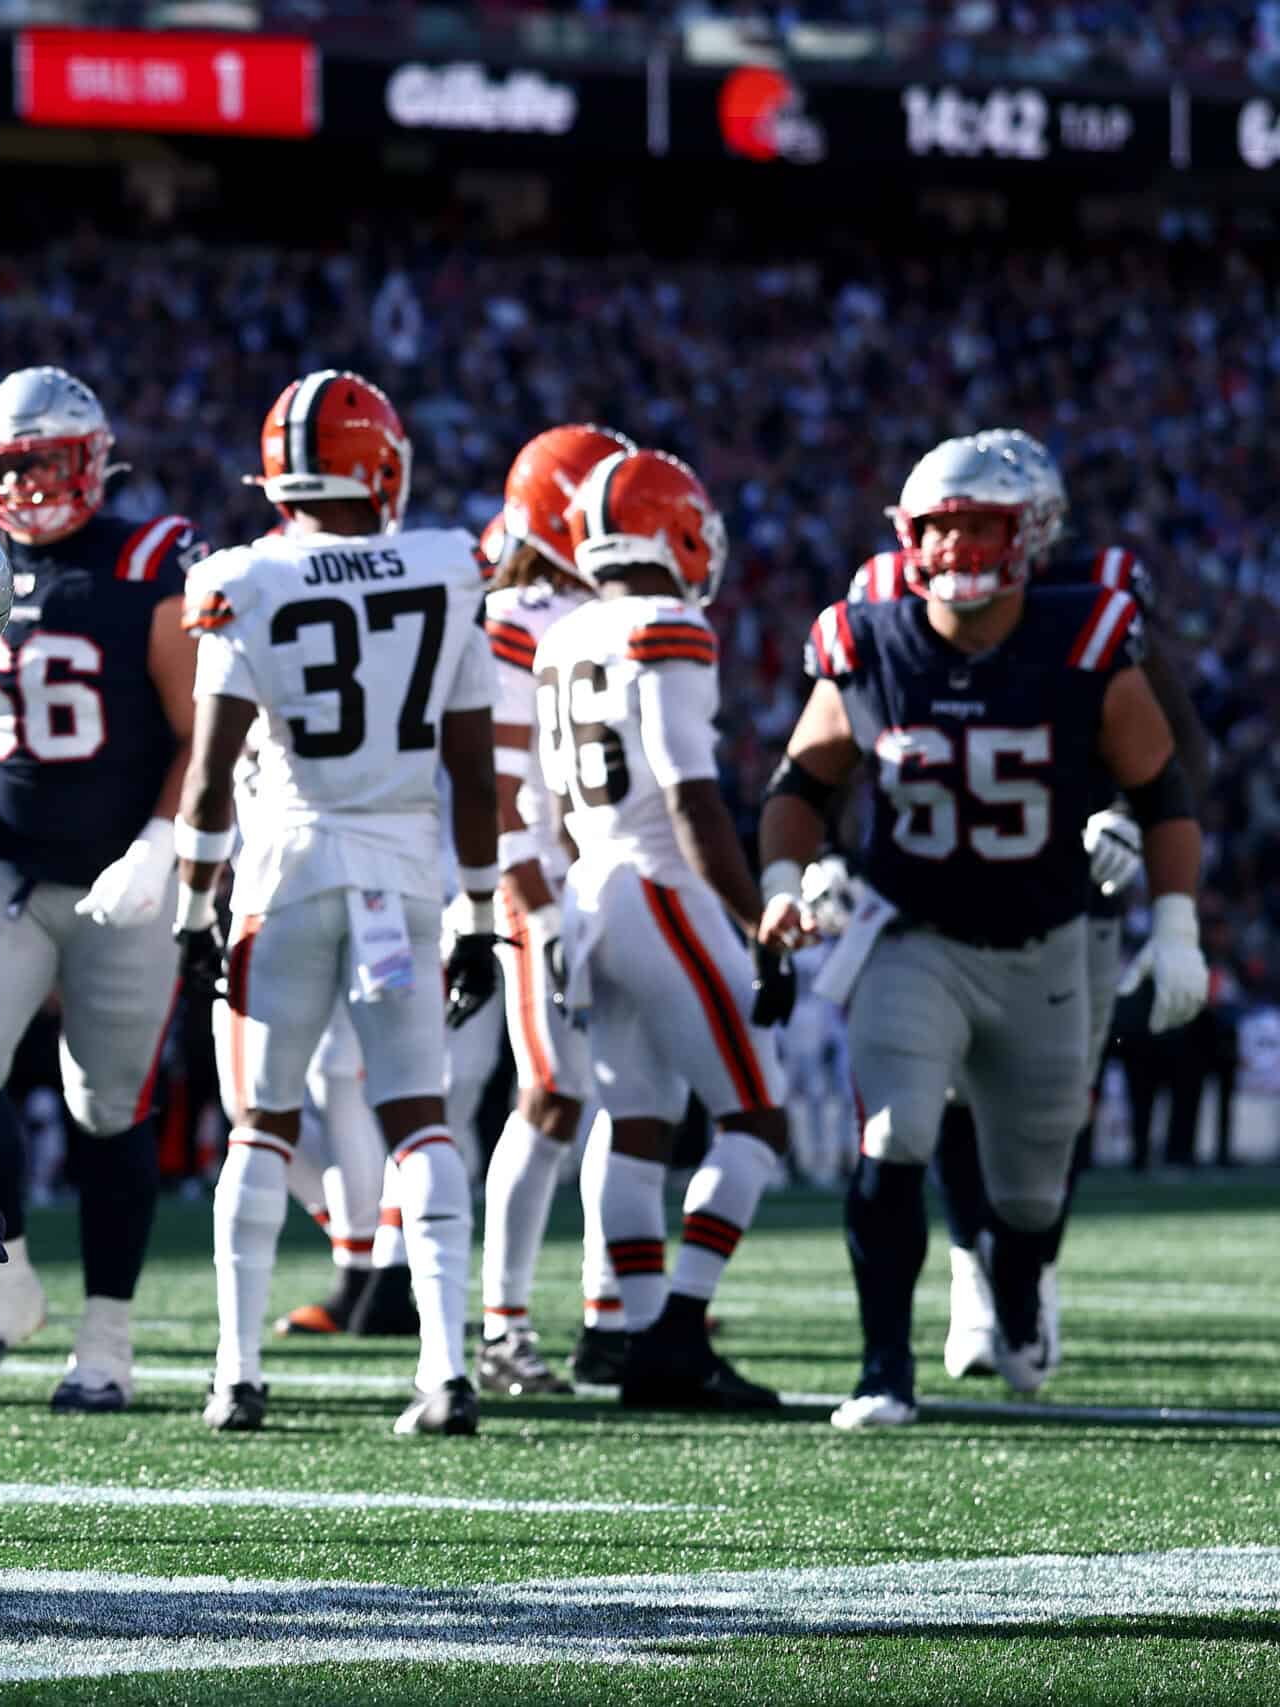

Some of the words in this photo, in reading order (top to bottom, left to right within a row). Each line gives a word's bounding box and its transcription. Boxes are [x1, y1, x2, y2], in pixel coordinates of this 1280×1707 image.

[213, 49, 245, 121] 1
[303, 549, 406, 586] JONES
[270, 585, 447, 757] 37
[876, 723, 1053, 861] 65
